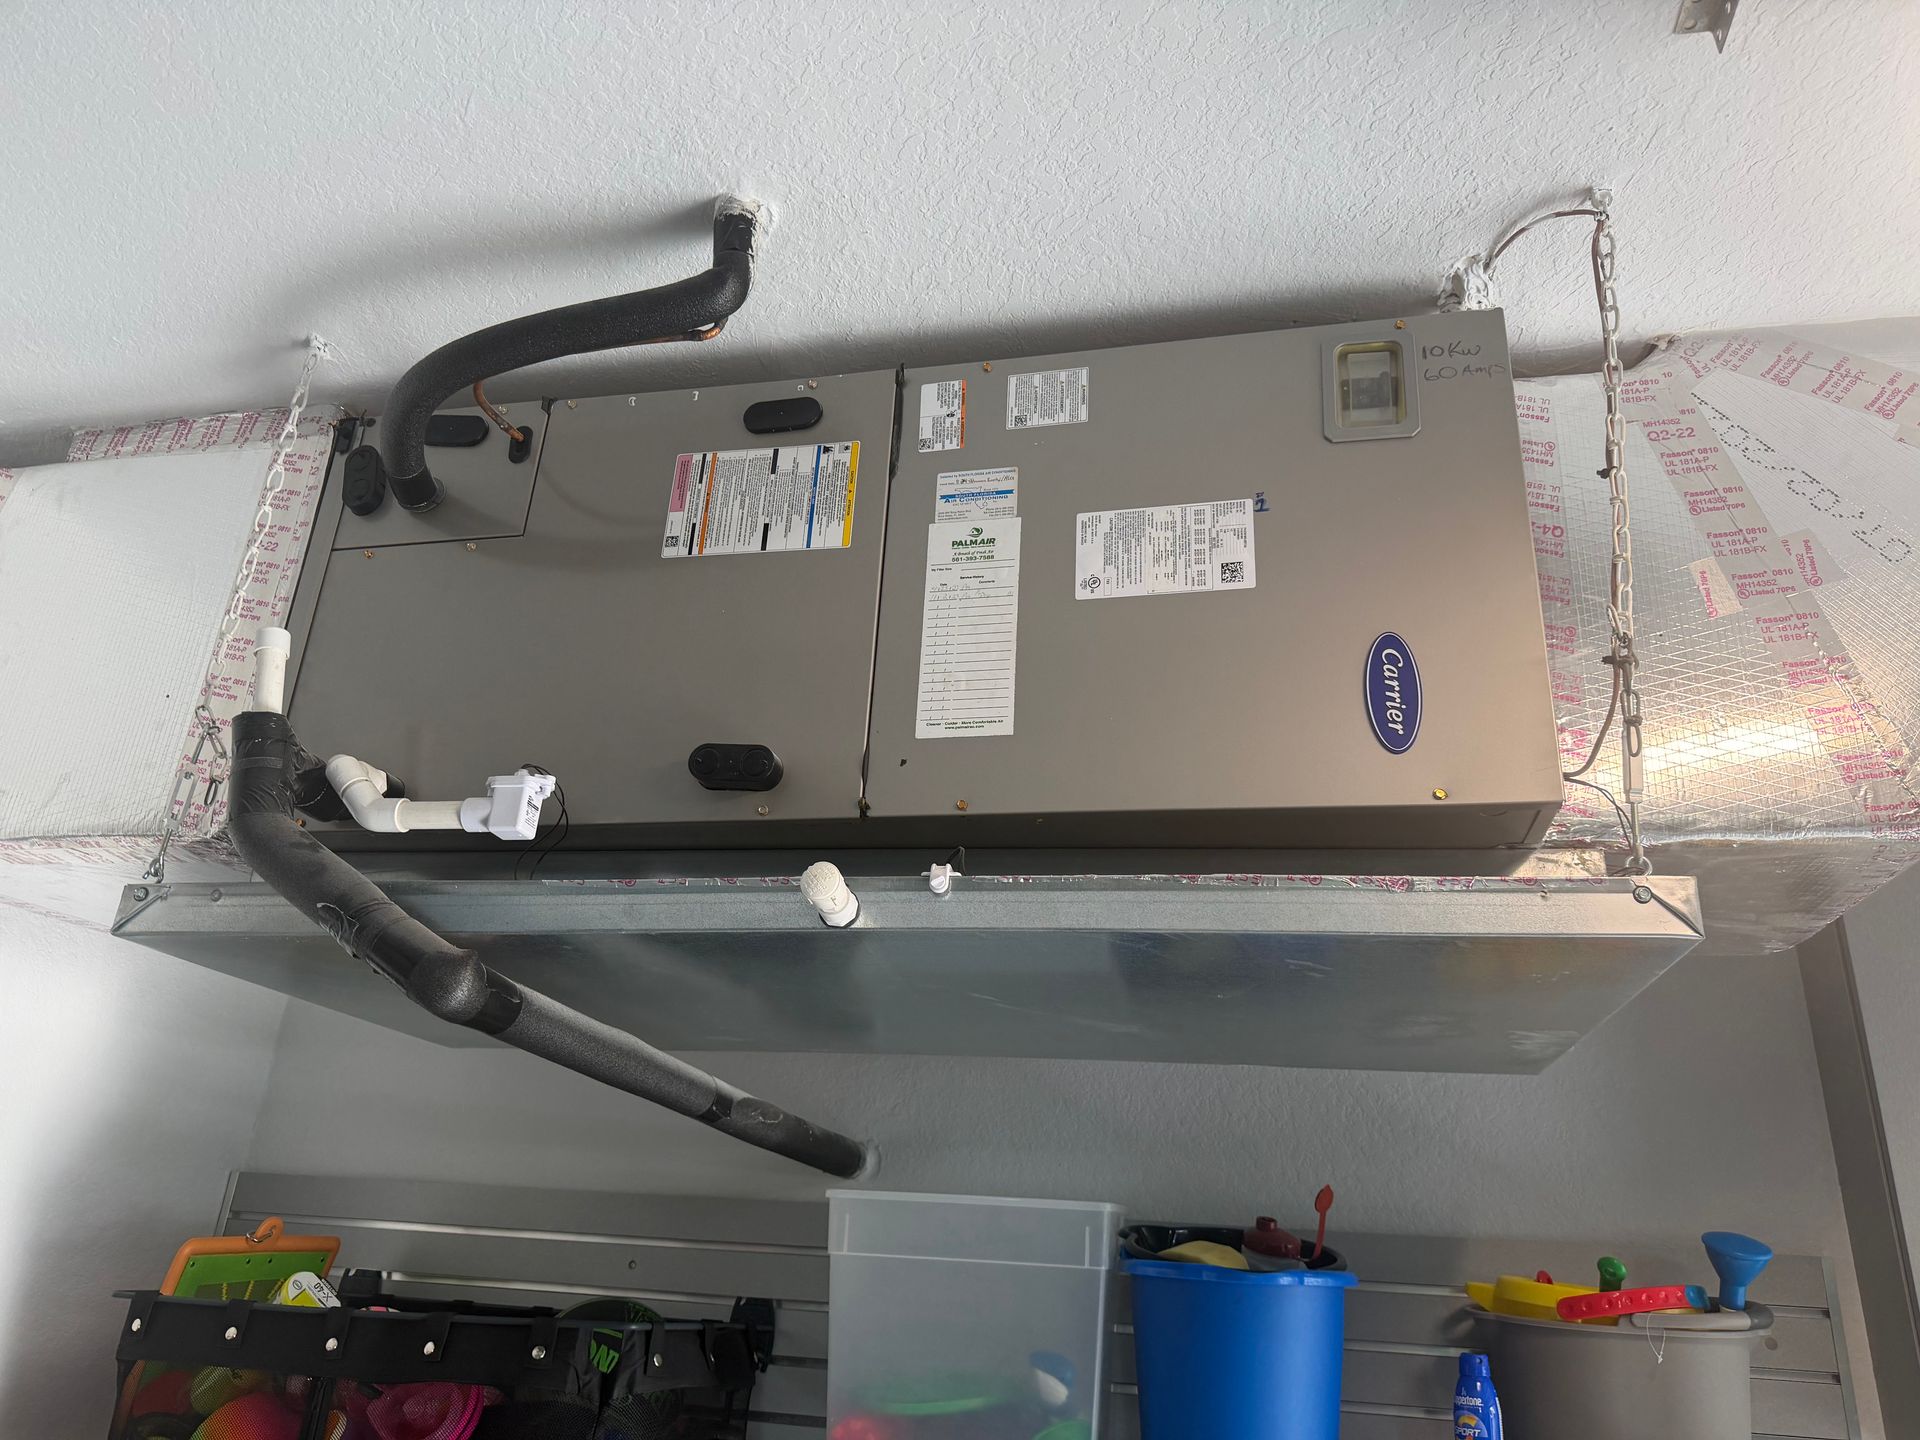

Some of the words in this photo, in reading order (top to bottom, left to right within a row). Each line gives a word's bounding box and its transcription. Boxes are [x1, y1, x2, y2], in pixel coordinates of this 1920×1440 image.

[1647, 427, 1696, 442] Q2-22
[1680, 456, 1710, 466] 181A-P
[1682, 464, 1718, 474] 181B-FX
[1746, 526, 1768, 535] 0810
[1726, 537, 1758, 547] 181A-P
[1729, 545, 1768, 556] 181B-FX
[1736, 579, 1777, 589] MH14352
[1382, 648, 1406, 734] Carrier
